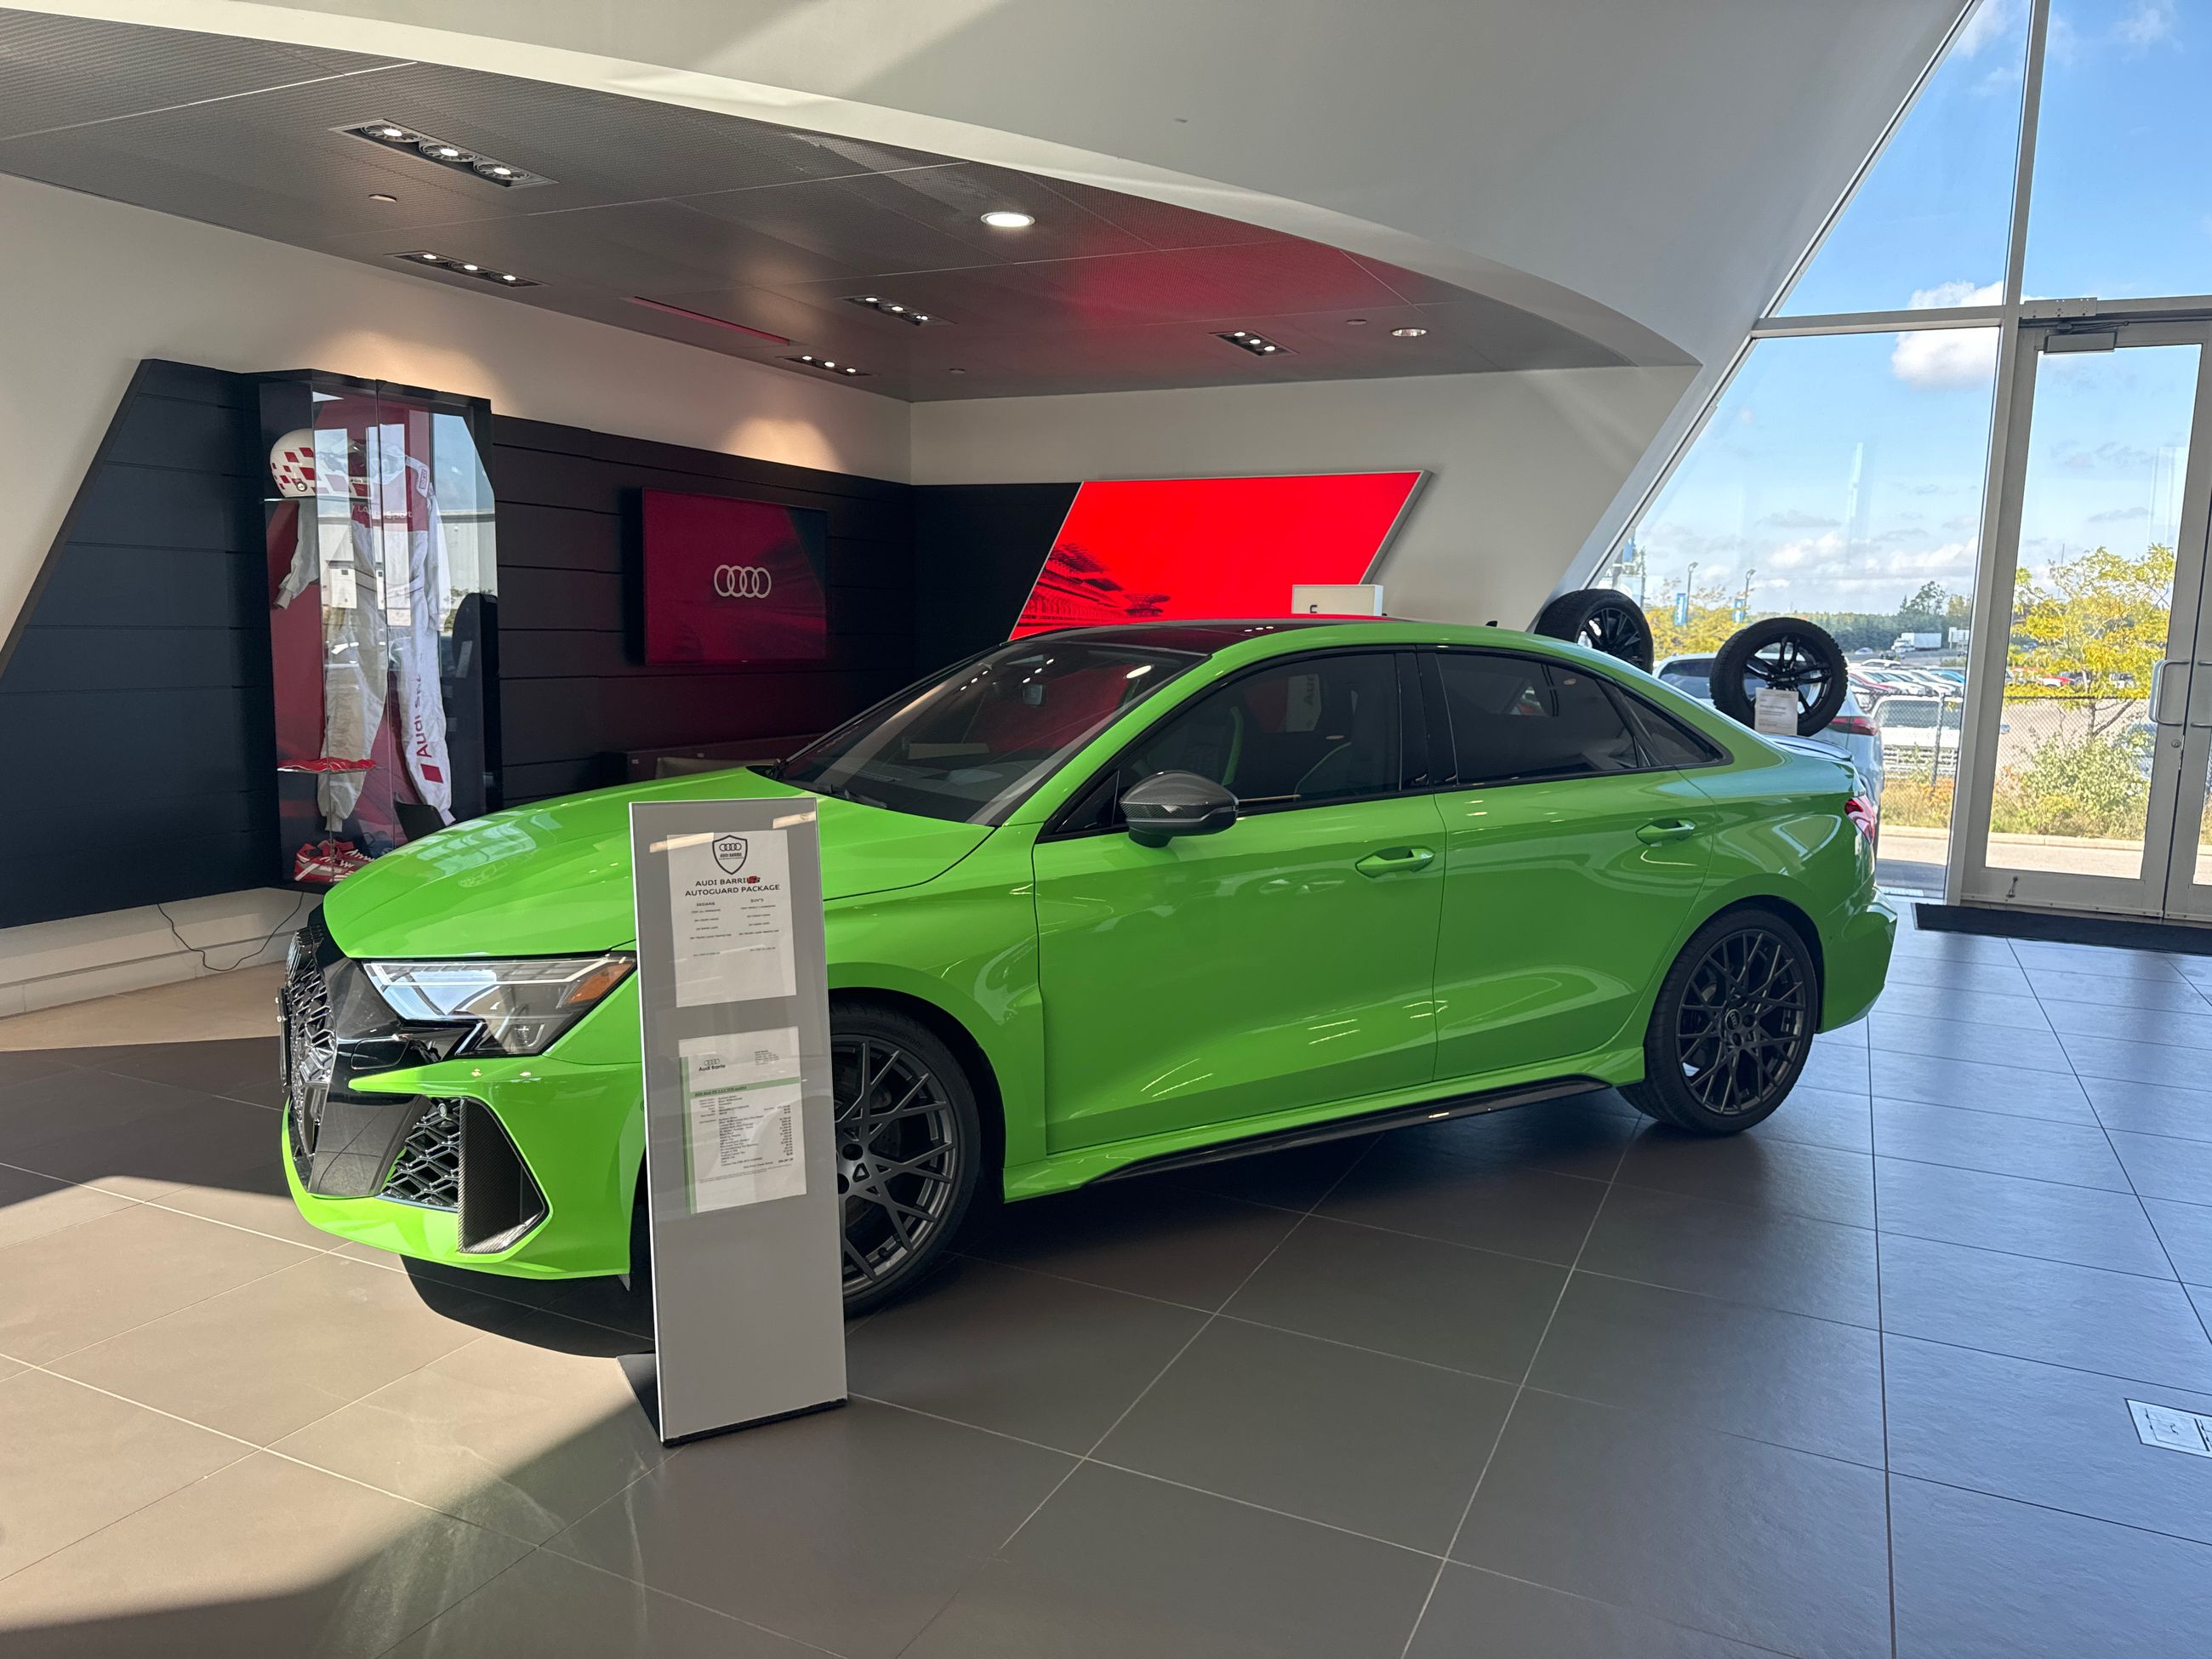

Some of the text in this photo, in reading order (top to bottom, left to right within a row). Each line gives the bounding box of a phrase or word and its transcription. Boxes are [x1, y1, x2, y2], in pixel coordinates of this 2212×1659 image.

[414, 715, 432, 758] Audi
[685, 884, 780, 897] AUTOGUARD PACKAGE
